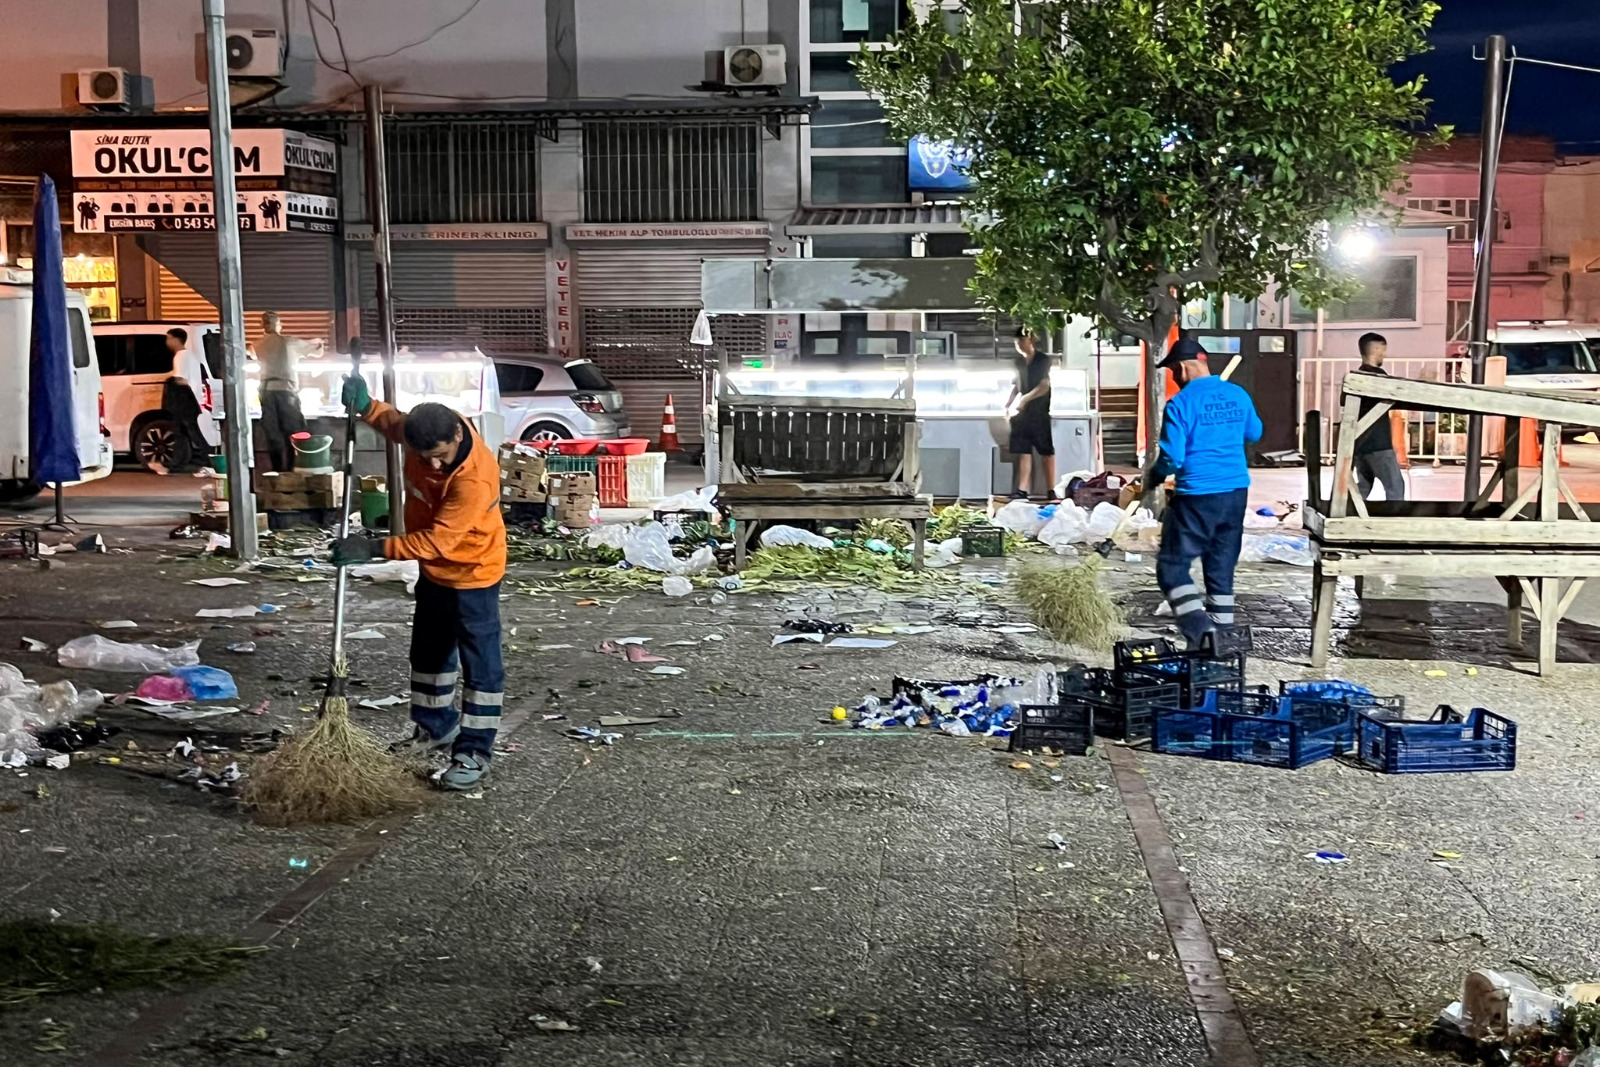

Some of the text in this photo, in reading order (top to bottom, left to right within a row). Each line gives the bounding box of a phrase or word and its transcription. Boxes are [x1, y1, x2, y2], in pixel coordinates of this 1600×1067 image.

[94, 146, 261, 174] OKUL'CM
[184, 217, 201, 230] 543
[203, 217, 216, 230] 54
